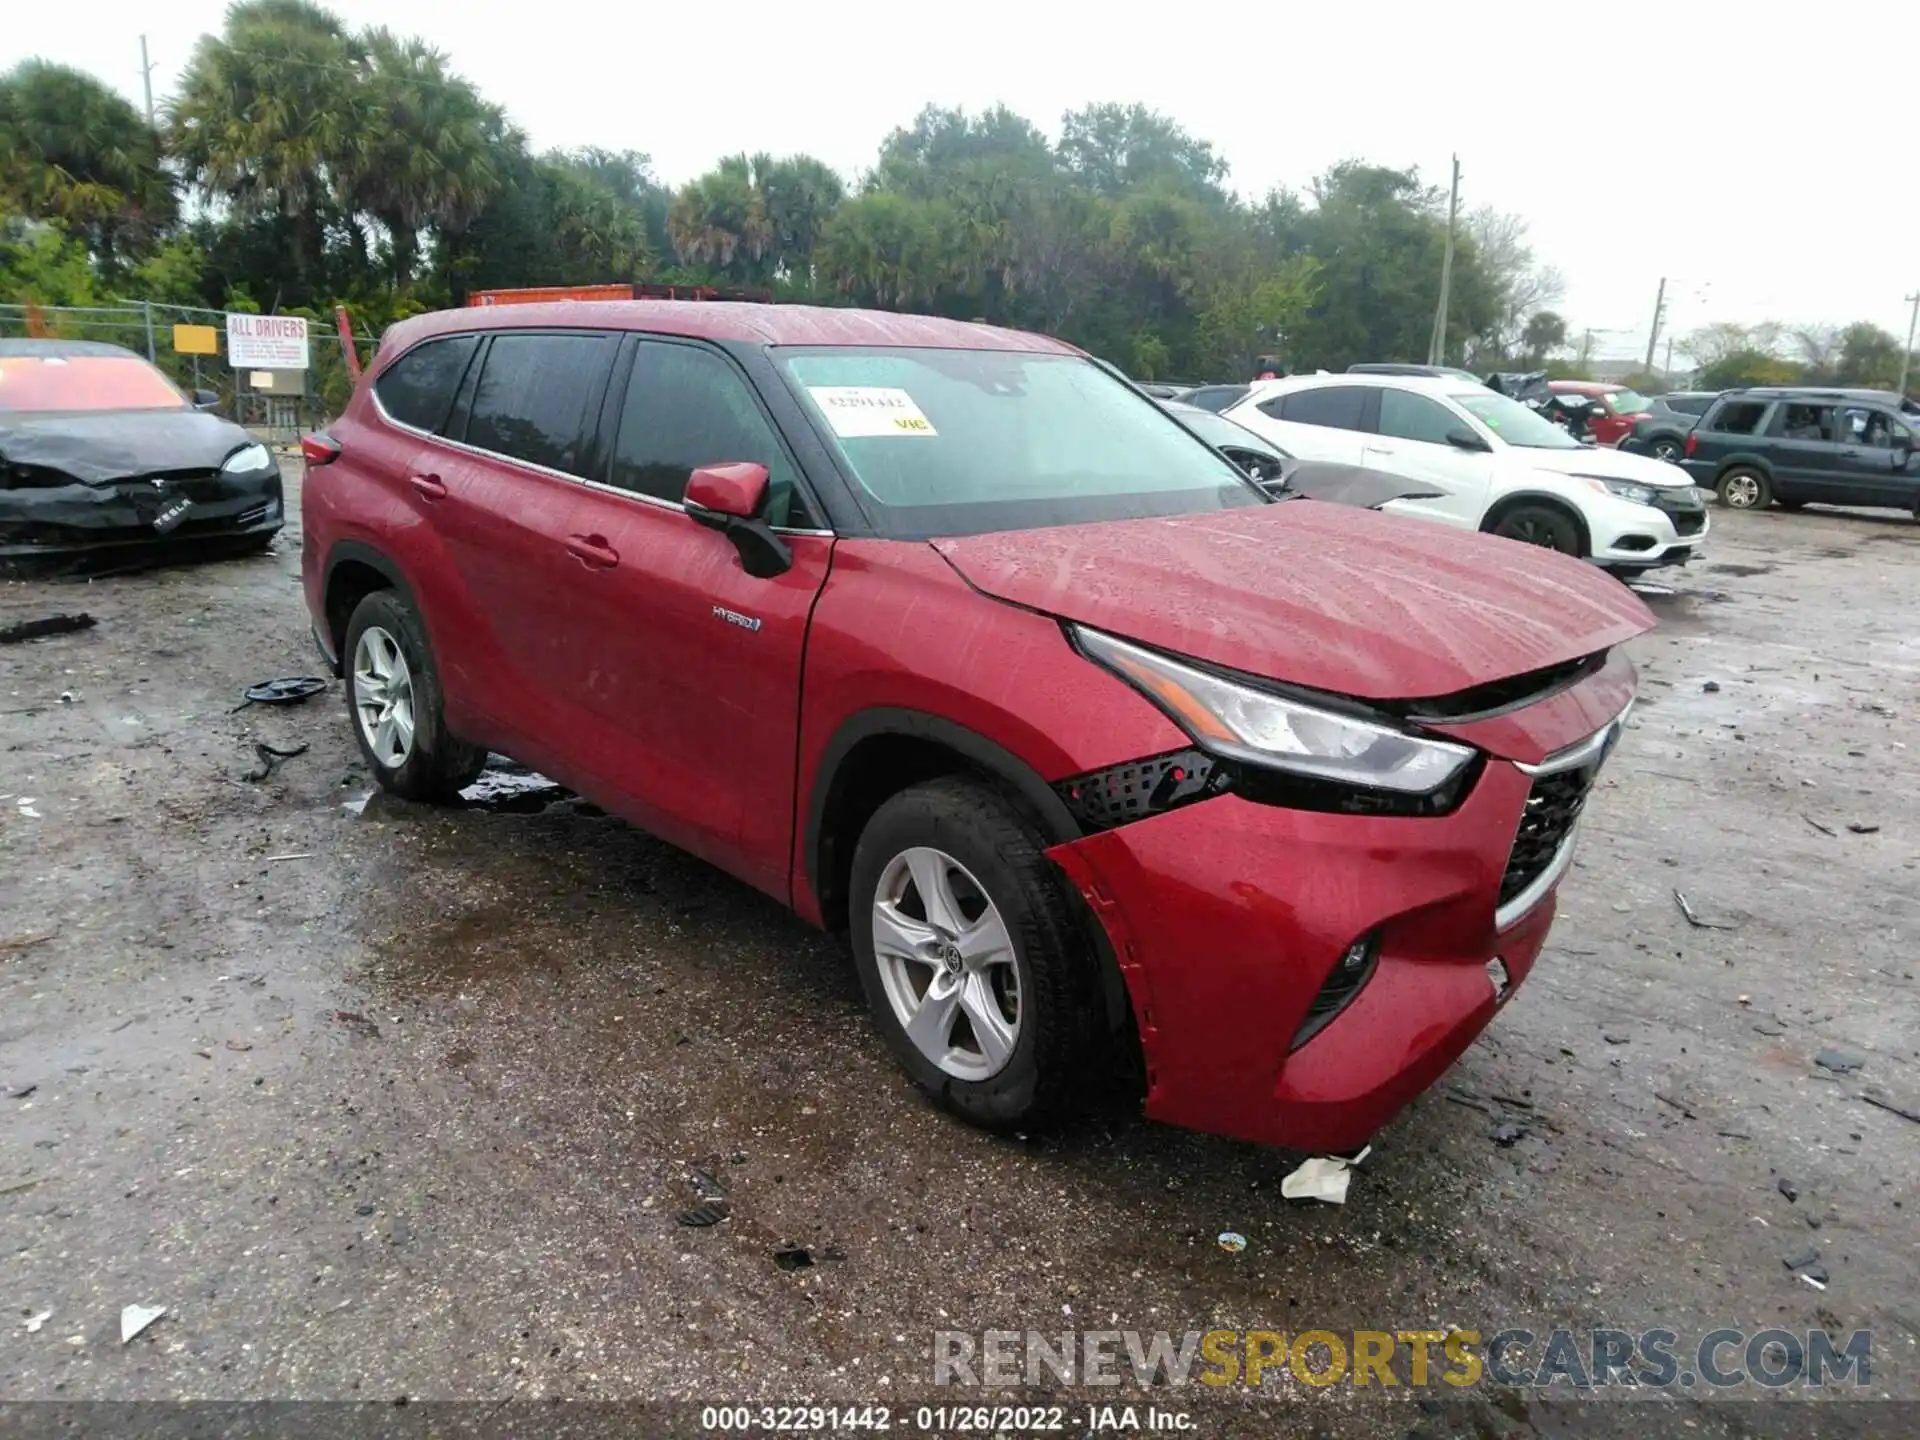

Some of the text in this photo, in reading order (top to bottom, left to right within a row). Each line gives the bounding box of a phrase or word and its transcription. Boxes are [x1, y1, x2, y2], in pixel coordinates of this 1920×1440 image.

[231, 318, 305, 340] ALL DRIVERS
[153, 498, 192, 527] TESLA
[712, 605, 754, 629] HYBRID
